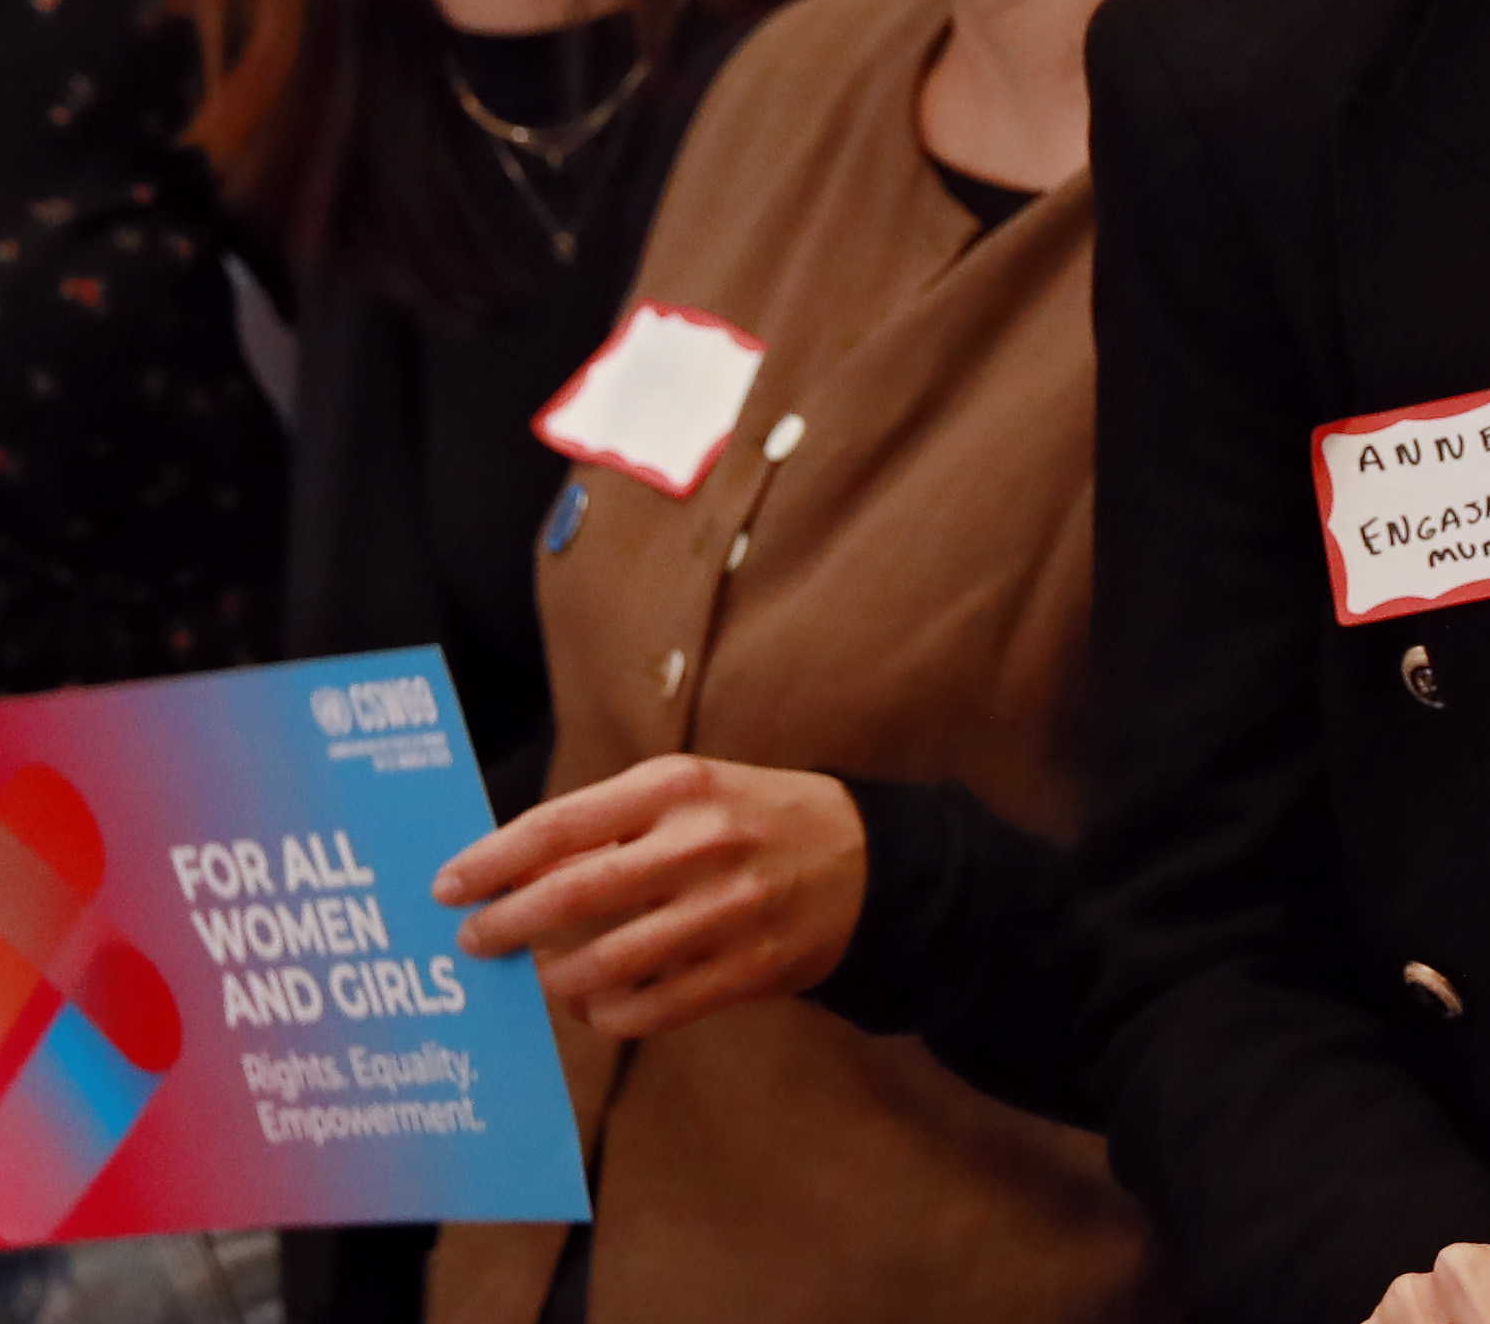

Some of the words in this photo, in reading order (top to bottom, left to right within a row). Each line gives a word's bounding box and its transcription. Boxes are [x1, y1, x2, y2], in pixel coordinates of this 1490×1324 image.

[169, 838, 276, 903] FOR
[282, 830, 375, 892] ALL
[190, 894, 389, 965] WOMEN
[221, 966, 324, 1030] AND
[329, 955, 466, 1019] GIRLS
[241, 1050, 348, 1103] Rights.
[347, 1040, 478, 1093] Equality.
[255, 1097, 486, 1146] Empowerment.
